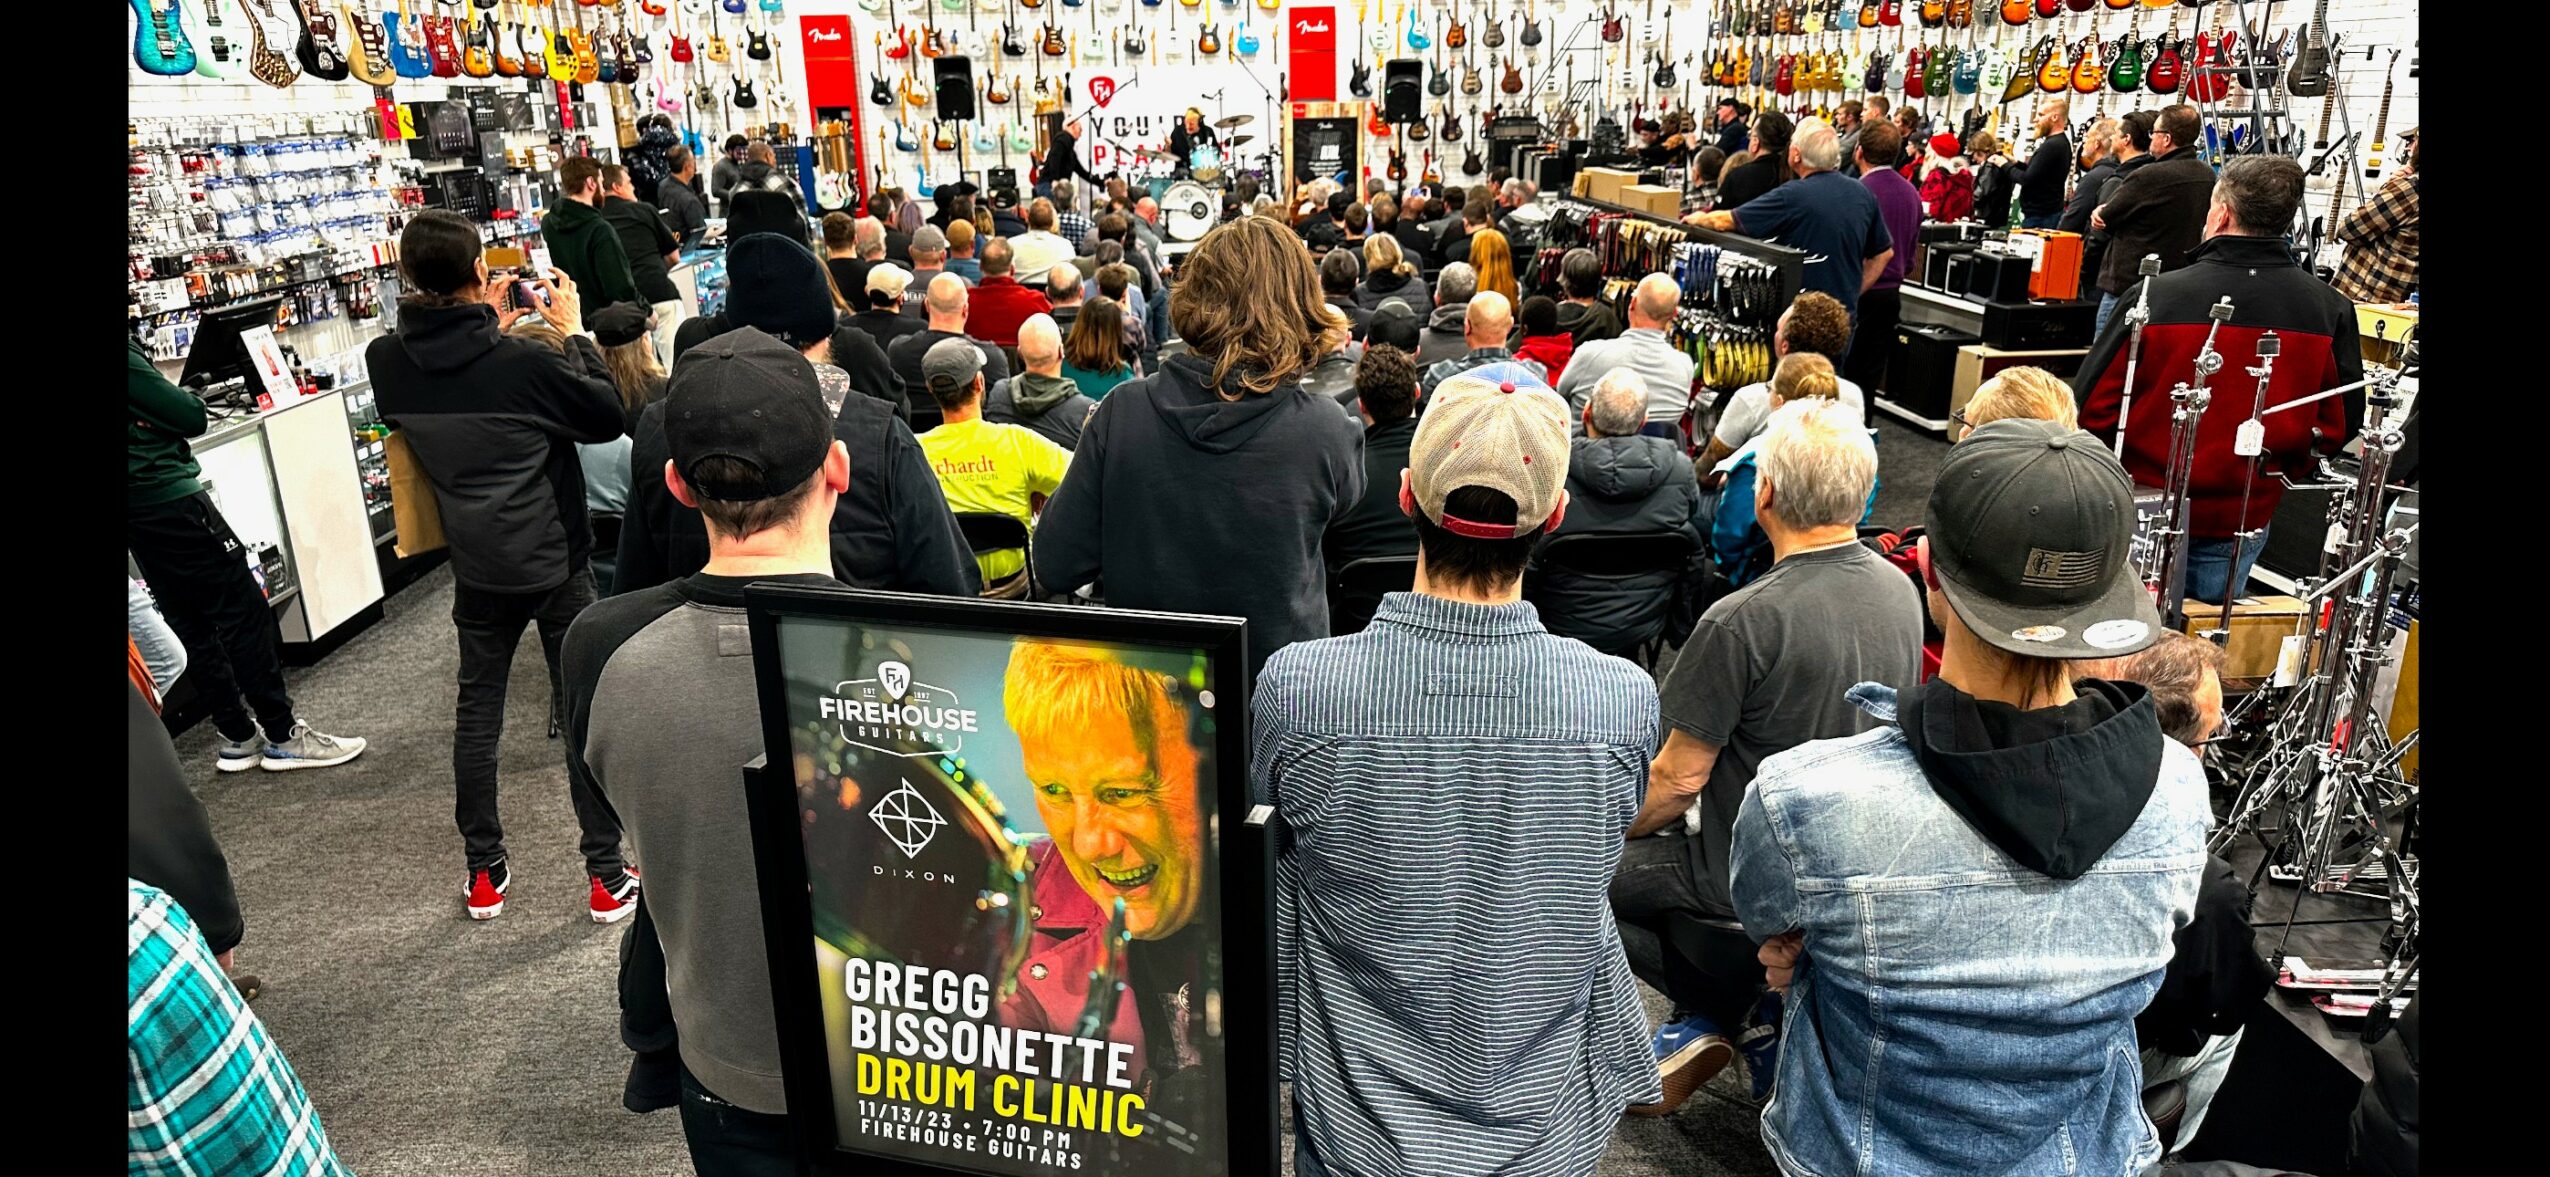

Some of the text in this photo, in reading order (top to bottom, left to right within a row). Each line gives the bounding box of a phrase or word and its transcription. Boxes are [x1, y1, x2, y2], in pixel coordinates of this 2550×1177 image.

[819, 697, 978, 732] FIREHOUSE
[858, 726, 944, 744] GUITARS
[845, 957, 990, 1019] GREGG
[851, 1005, 1135, 1089] BISSONETTE
[857, 1052, 1146, 1138] DRUM CLINIC
[858, 1099, 1071, 1150] 11/13/23 7:00 PM
[861, 1118, 1082, 1170] FIREHOUSE GUITARS
